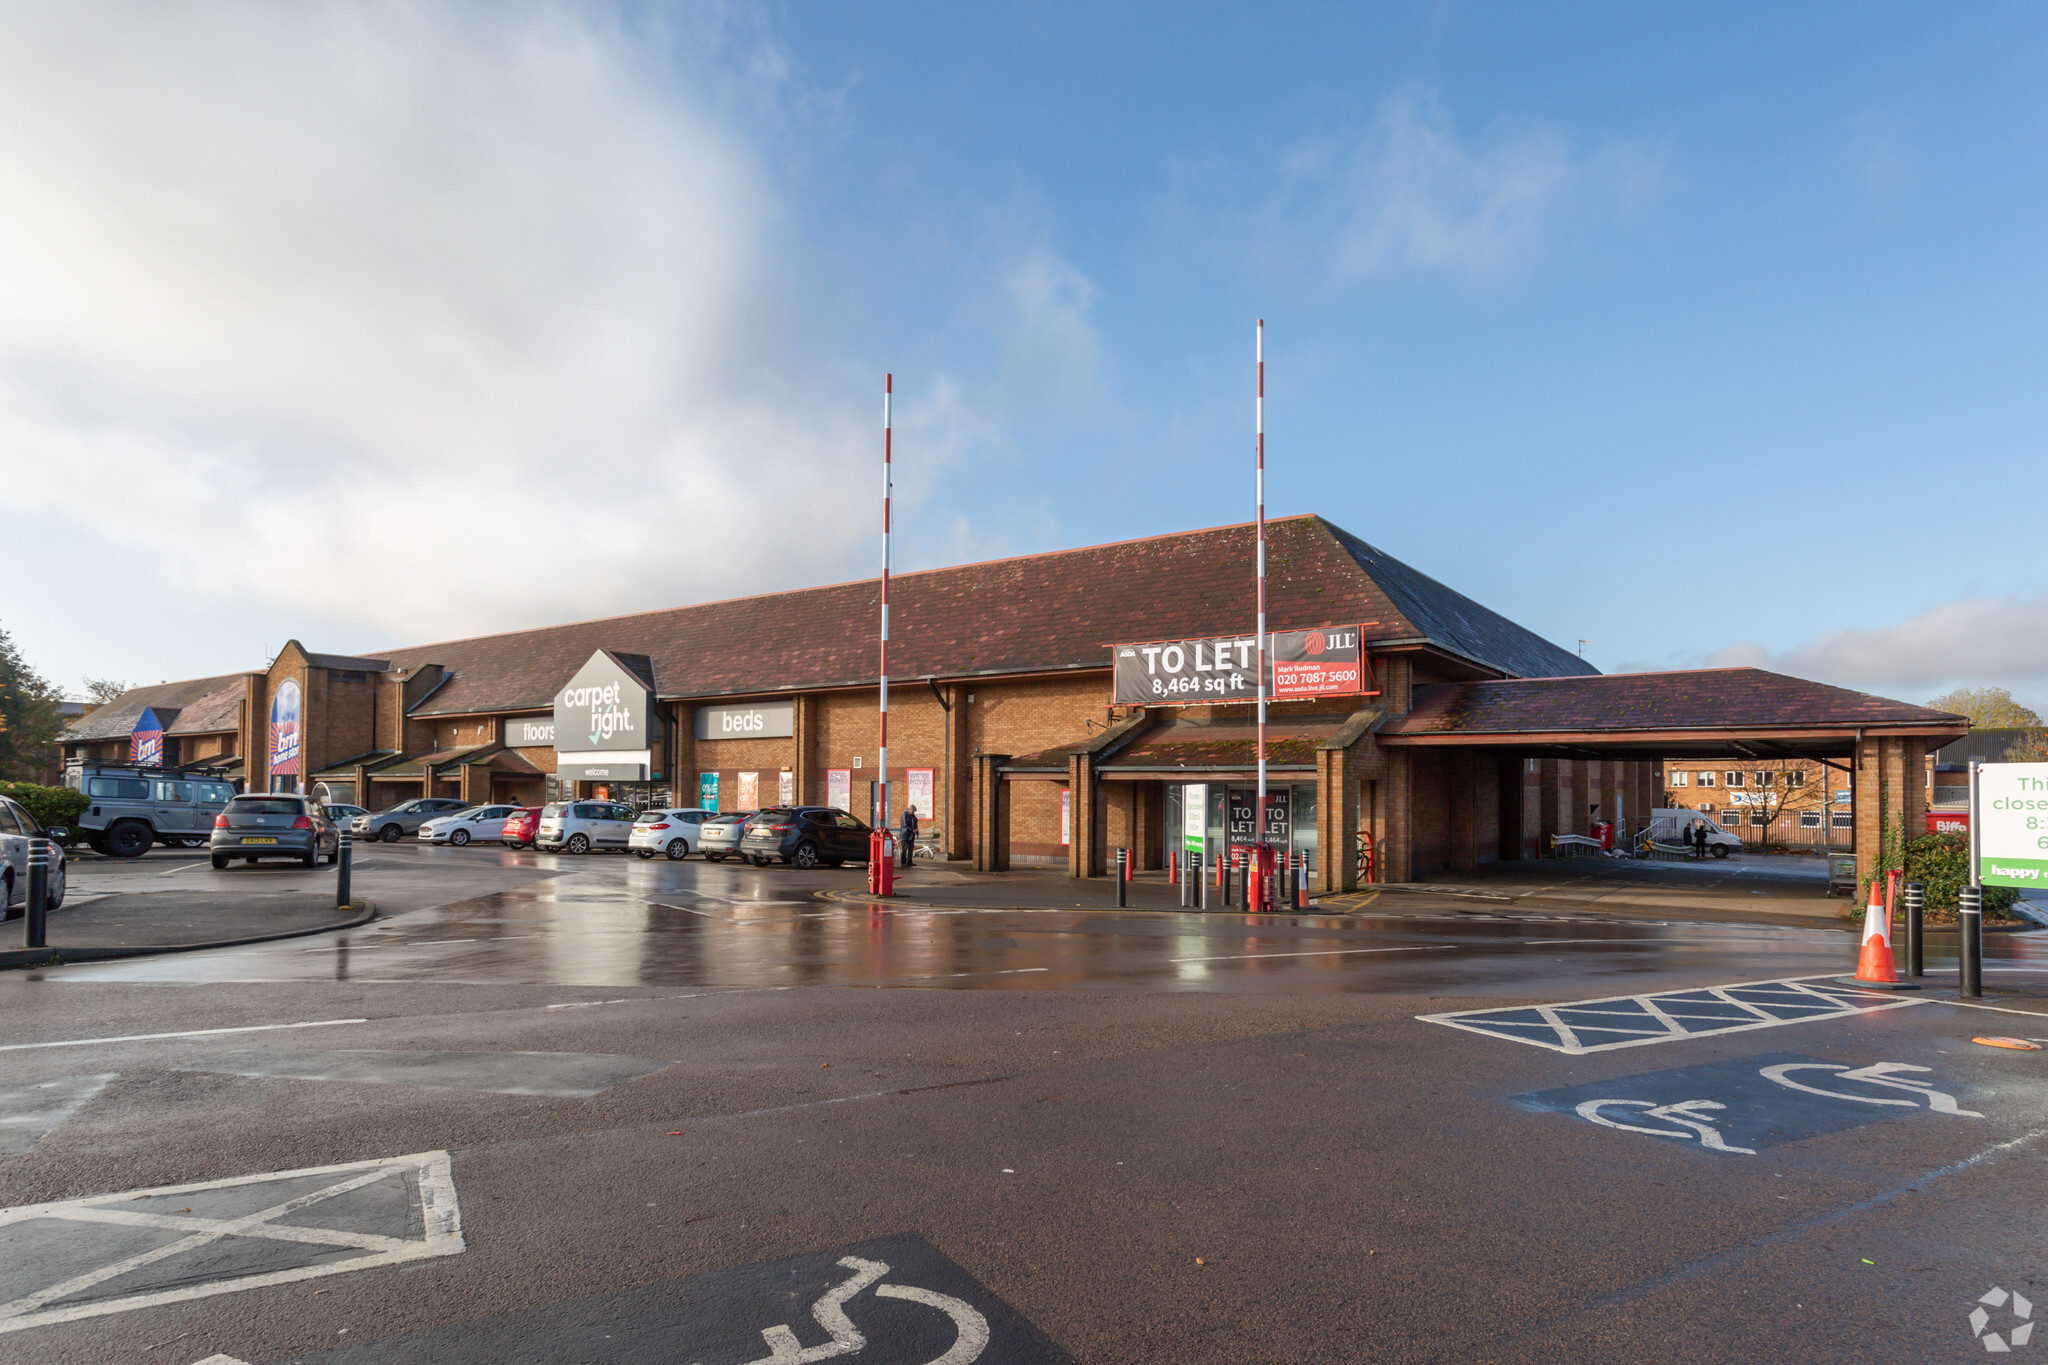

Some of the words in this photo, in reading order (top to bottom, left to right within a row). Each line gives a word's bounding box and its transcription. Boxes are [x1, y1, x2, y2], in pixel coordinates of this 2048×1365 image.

[1326, 633, 1354, 650] JLL
[1142, 645, 1184, 674] TO
[1195, 640, 1255, 672] LET
[1278, 665, 1293, 673] Mark
[1152, 676, 1200, 698] 8,464
[1204, 678, 1225, 695] sq
[1229, 672, 1245, 690] ft
[1277, 674, 1298, 685] 020
[1300, 672, 1326, 684] 7087
[1328, 670, 1356, 682] 5600
[564, 681, 620, 712] carpet
[722, 709, 763, 732] beds
[523, 723, 554, 741] floors
[585, 767, 610, 777] welcome
[1233, 807, 1251, 819] TO
[1266, 808, 1284, 820] TO
[1231, 821, 1255, 833] LET
[1936, 820, 1967, 833] Biffa
[1991, 864, 2040, 880] happy
